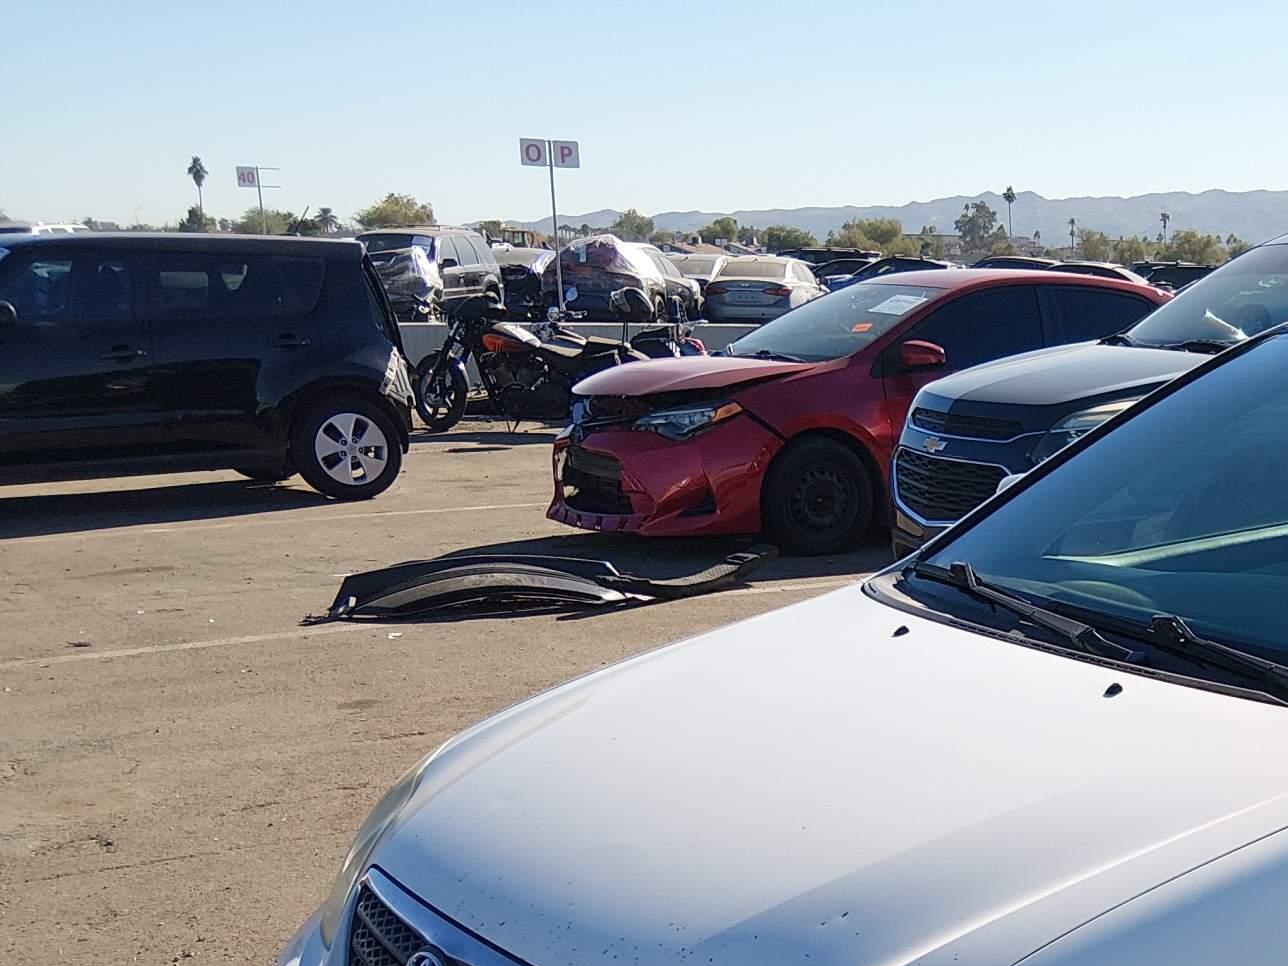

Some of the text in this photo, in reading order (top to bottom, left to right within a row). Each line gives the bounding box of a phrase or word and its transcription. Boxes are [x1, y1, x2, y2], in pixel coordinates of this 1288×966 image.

[525, 143, 573, 164] O P
[239, 171, 255, 184] 40
